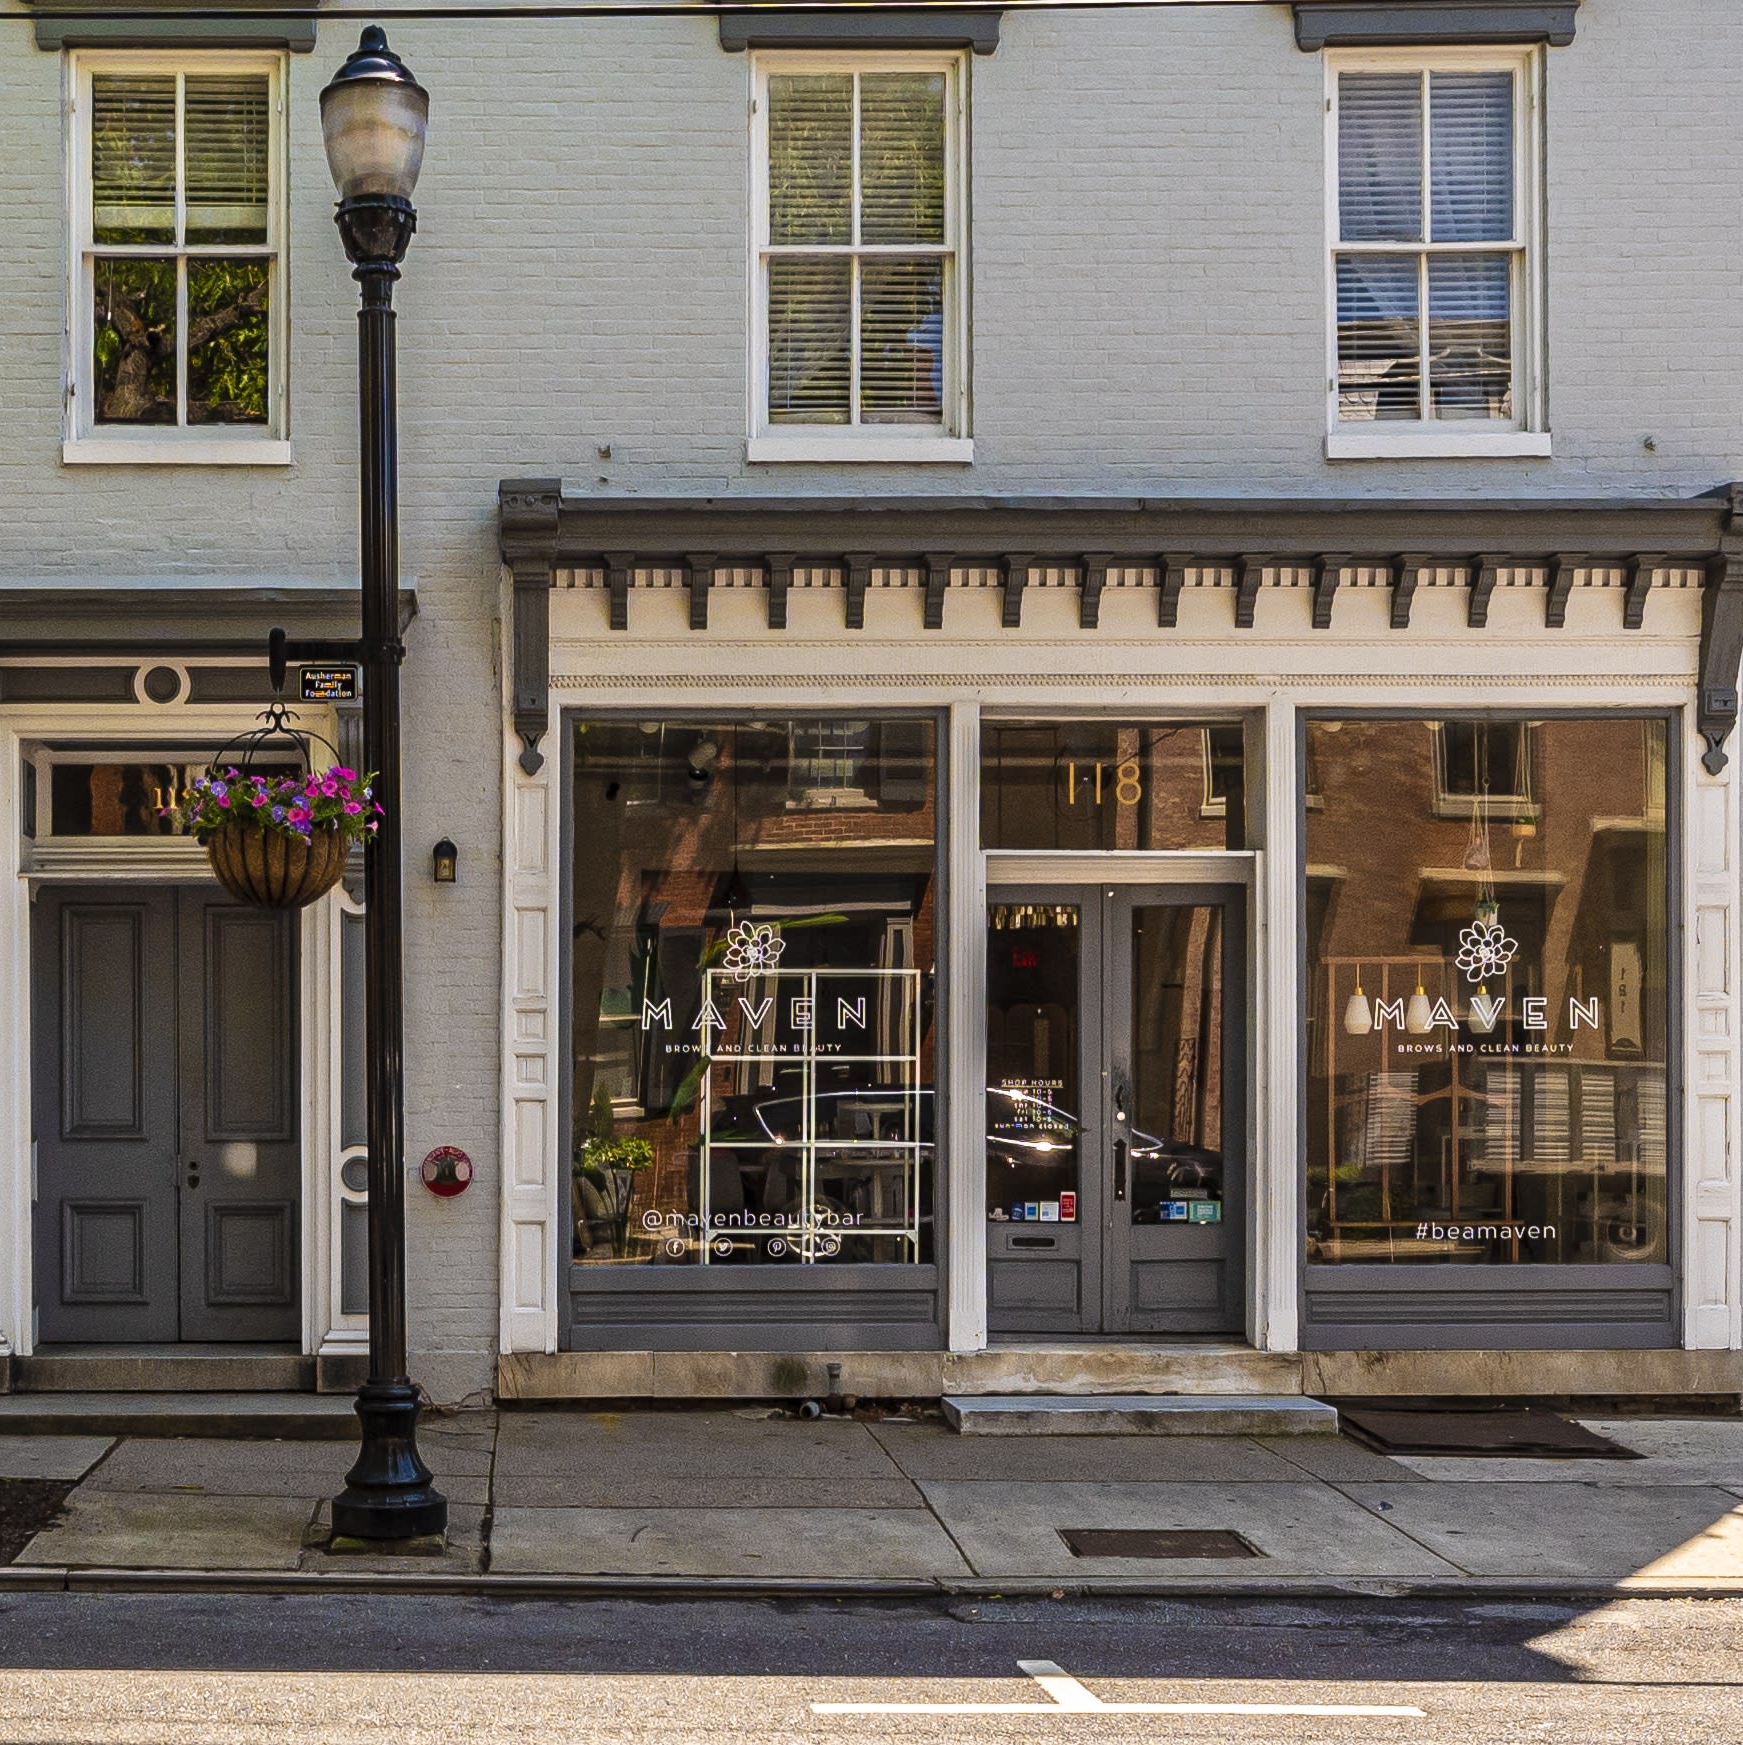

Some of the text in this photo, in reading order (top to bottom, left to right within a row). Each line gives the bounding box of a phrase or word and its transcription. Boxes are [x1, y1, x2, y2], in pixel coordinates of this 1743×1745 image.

[1069, 762, 1142, 804] 118
[641, 997, 866, 1030] MAVEN
[1374, 996, 1599, 1030] MAVEN
[717, 1044, 741, 1053] AND
[748, 1044, 787, 1053] CLEAN
[1398, 1044, 1574, 1053] BROWS AND CLEAN BEAUTY
[1001, 1079, 1064, 1087] SHOP HOURS
[1416, 1222, 1556, 1240] #beamaven
